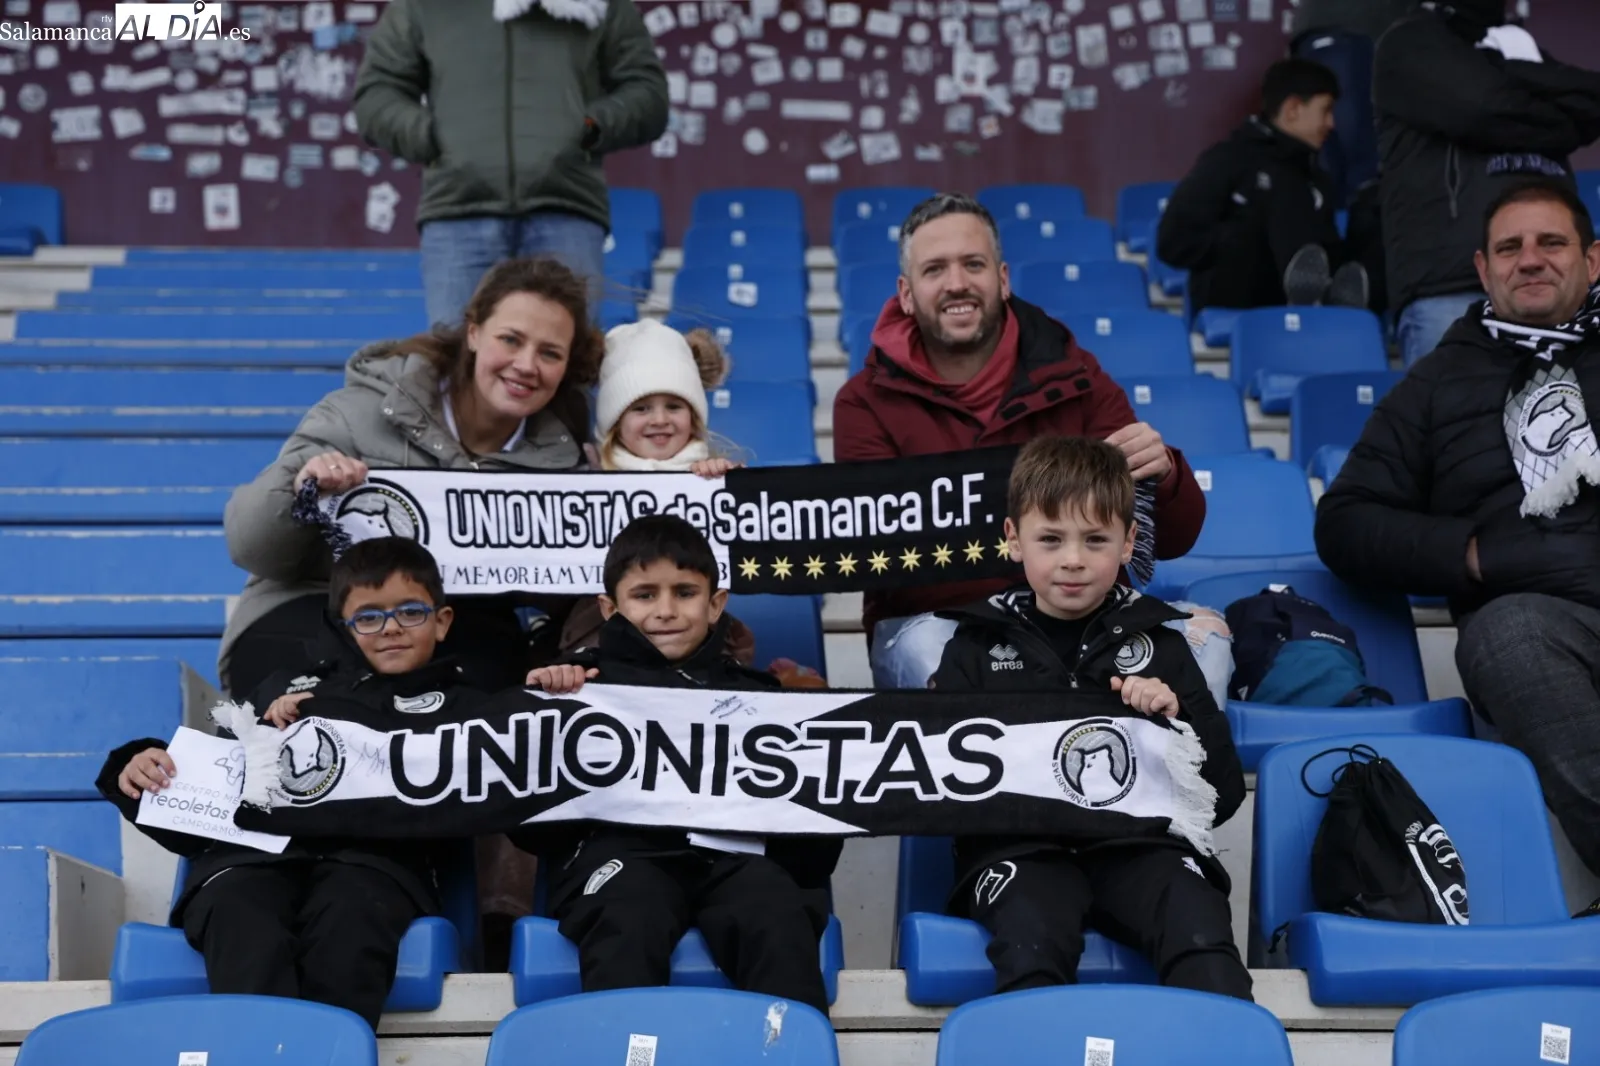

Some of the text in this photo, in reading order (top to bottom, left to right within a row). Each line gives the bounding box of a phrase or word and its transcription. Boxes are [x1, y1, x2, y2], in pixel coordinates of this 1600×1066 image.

[711, 488, 923, 546] Salamanca
[930, 472, 994, 529] C.F.
[388, 709, 1006, 801] UNIONISTAS
[175, 781, 220, 799] CENTRO
[150, 791, 230, 820] recoletas
[172, 815, 244, 838] CAMPOAMOR
